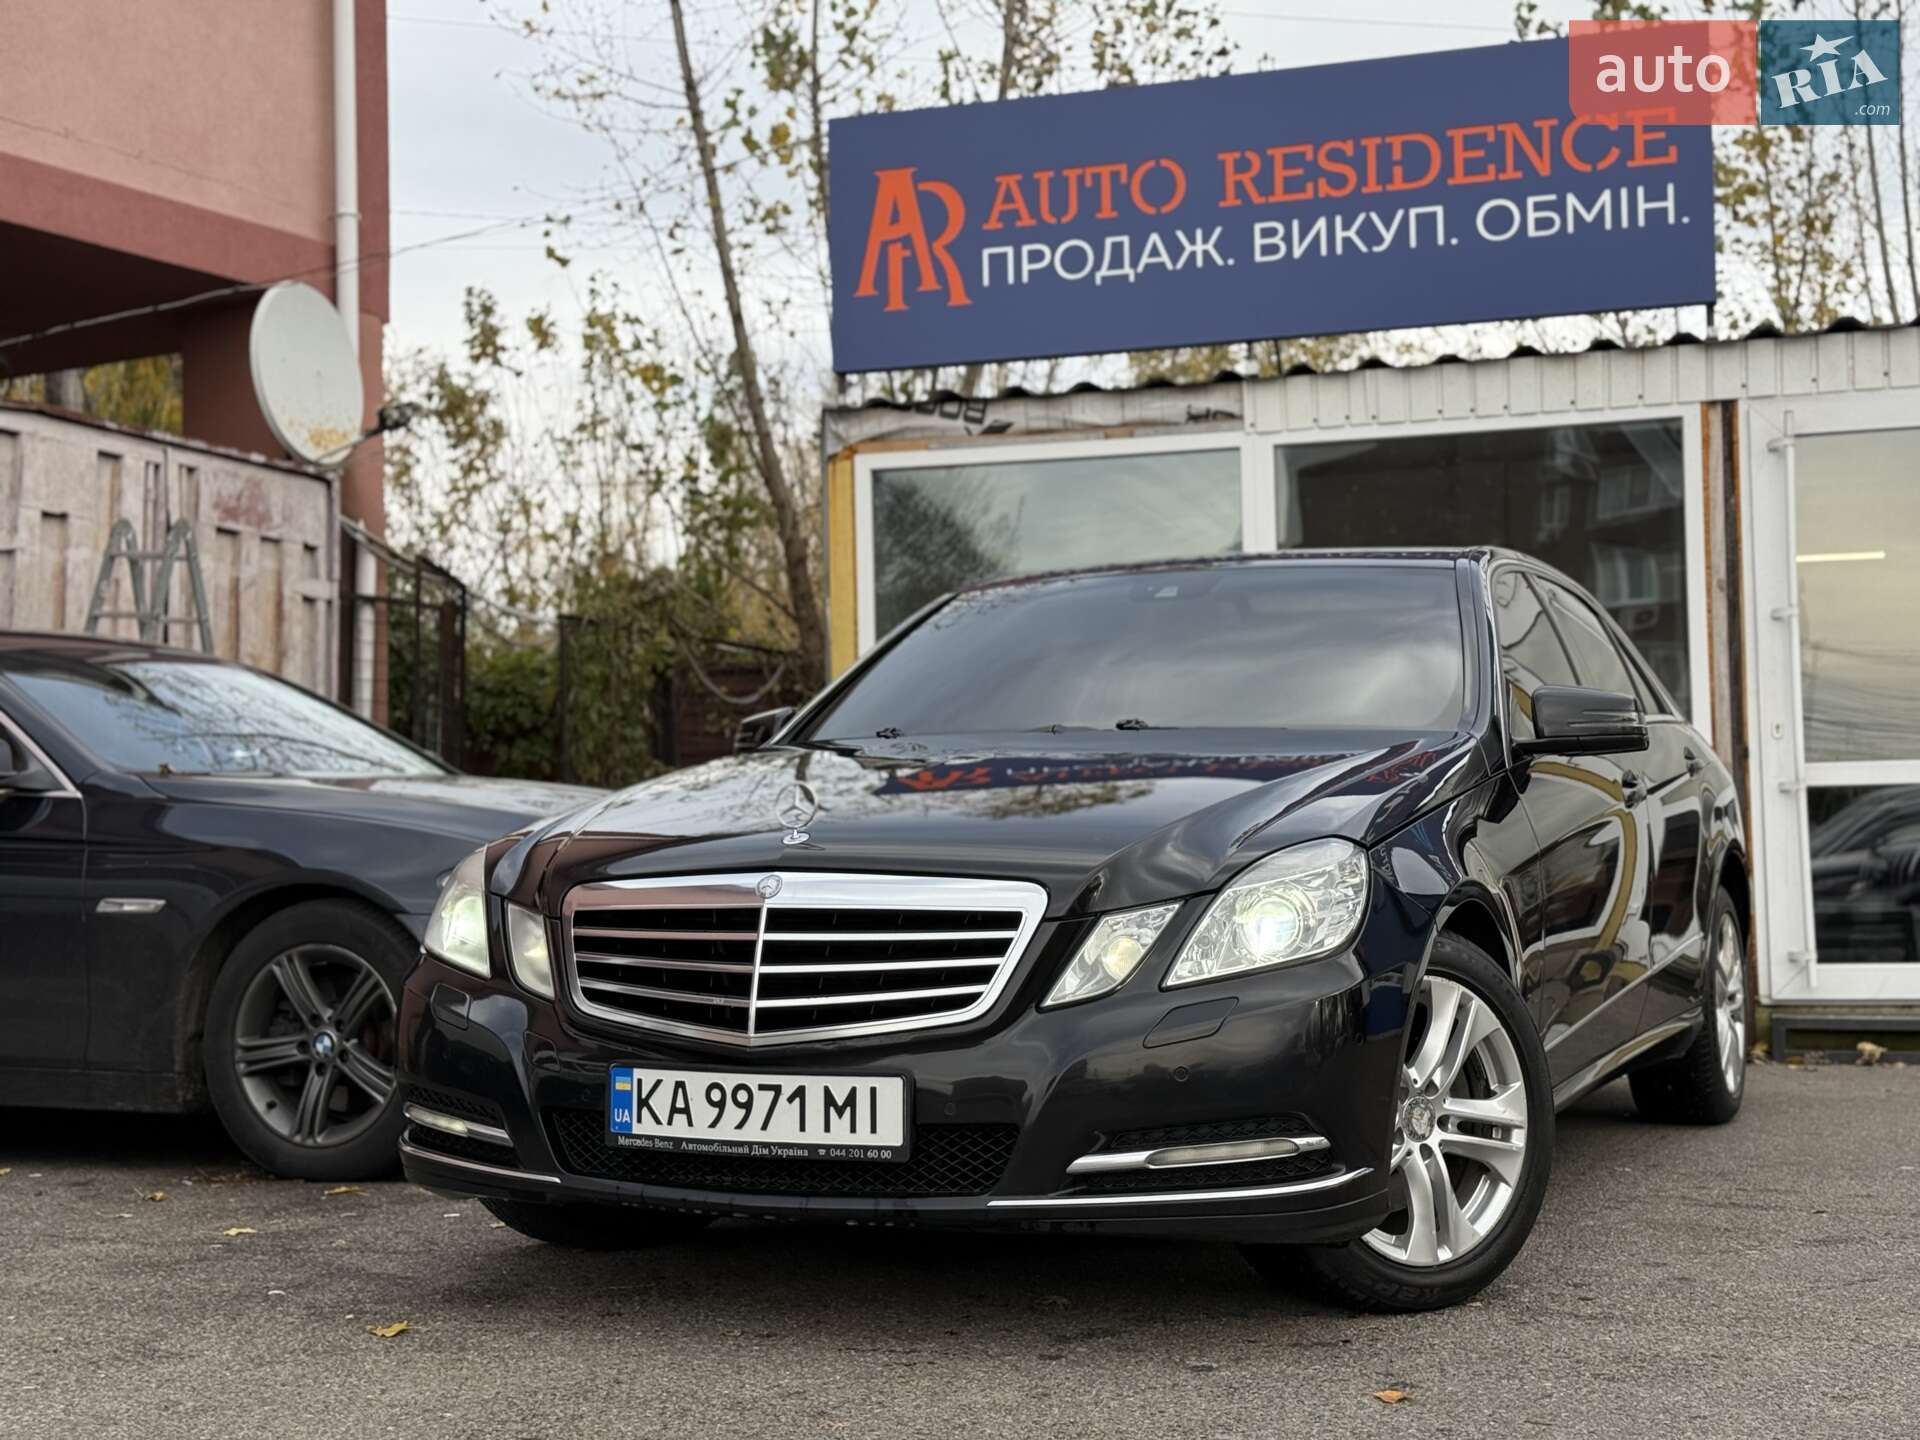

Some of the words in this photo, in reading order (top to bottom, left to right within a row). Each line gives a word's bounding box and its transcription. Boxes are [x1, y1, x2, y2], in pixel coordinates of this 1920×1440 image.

[982, 157, 1187, 230] AUTO
[1216, 107, 1679, 208] RESIDENCE
[981, 226, 1235, 287] ПРОДАЖ.
[1252, 204, 1460, 263] ВИКУП.
[1474, 182, 1691, 242] ОБМІН.
[614, 1107, 631, 1123] UA
[636, 1077, 694, 1127] KA
[704, 1081, 806, 1132] 9971
[823, 1085, 877, 1134] MI
[617, 1135, 653, 1148] Mercedes
[654, 1138, 674, 1149] Benz
[680, 1141, 750, 1155] Автомобільний
[750, 1144, 769, 1157] Дім
[770, 1145, 809, 1158] Україна
[829, 1148, 846, 1157] 044
[848, 1149, 865, 1158] 201
[866, 1149, 878, 1159] 60
[880, 1149, 892, 1159] 00
